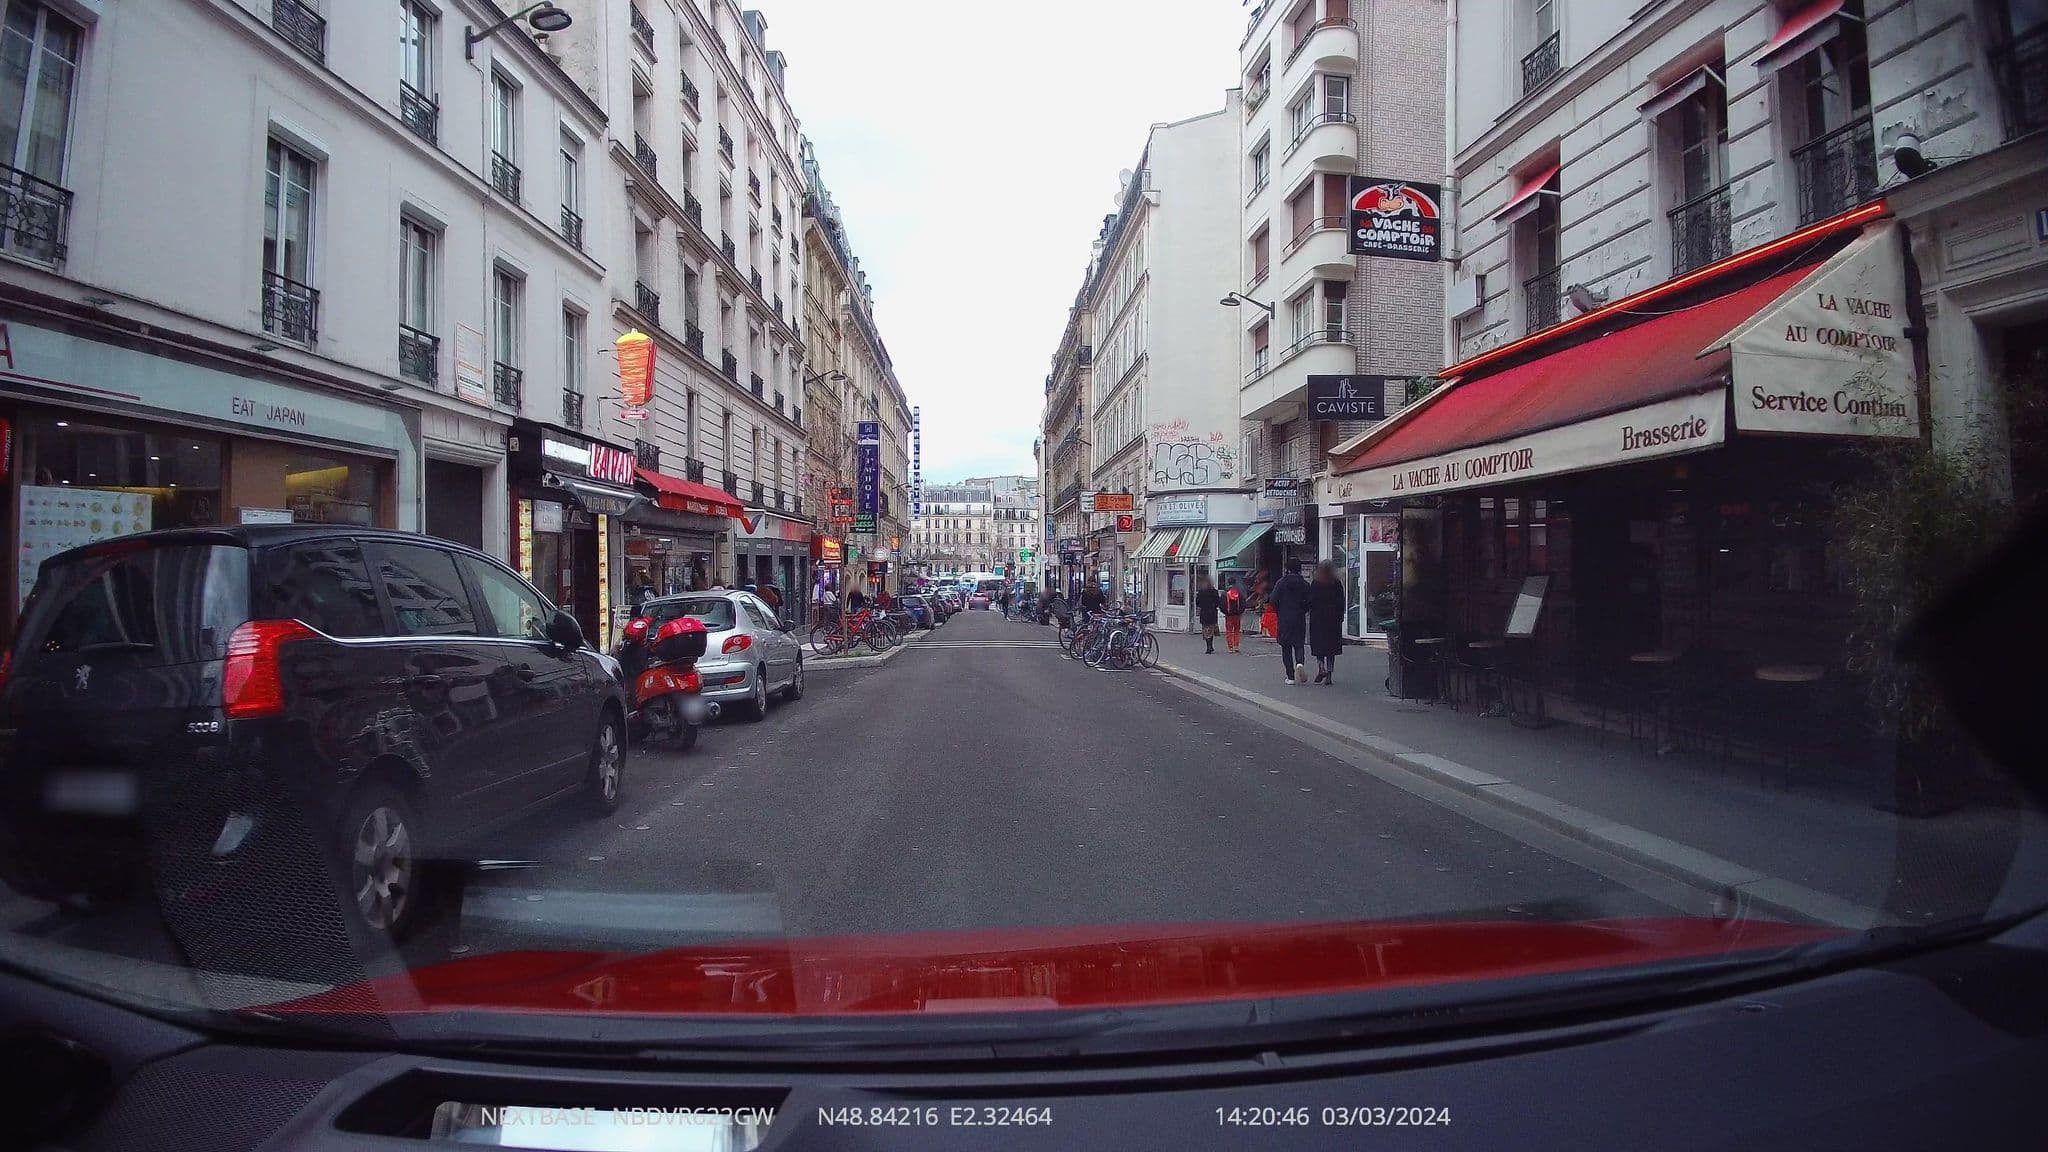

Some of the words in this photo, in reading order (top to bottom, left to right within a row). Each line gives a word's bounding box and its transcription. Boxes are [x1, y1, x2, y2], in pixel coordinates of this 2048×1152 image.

[1372, 217, 1420, 233] VACHE
[1817, 293, 1838, 311] LA
[1845, 297, 1892, 318] VACHE
[1785, 325, 1807, 342] AU
[1816, 327, 1896, 352] COMPTOIR
[232, 396, 256, 417] EAT
[266, 405, 305, 426] JAPAN
[1316, 401, 1376, 414] CAVISTE
[1751, 385, 1829, 413] Service
[1621, 414, 1708, 451] Brasserie
[1392, 473, 1404, 491] LA
[1408, 466, 1440, 487] VACHE
[1444, 462, 1460, 482] AU
[1465, 447, 1534, 480] COMPTOIR
